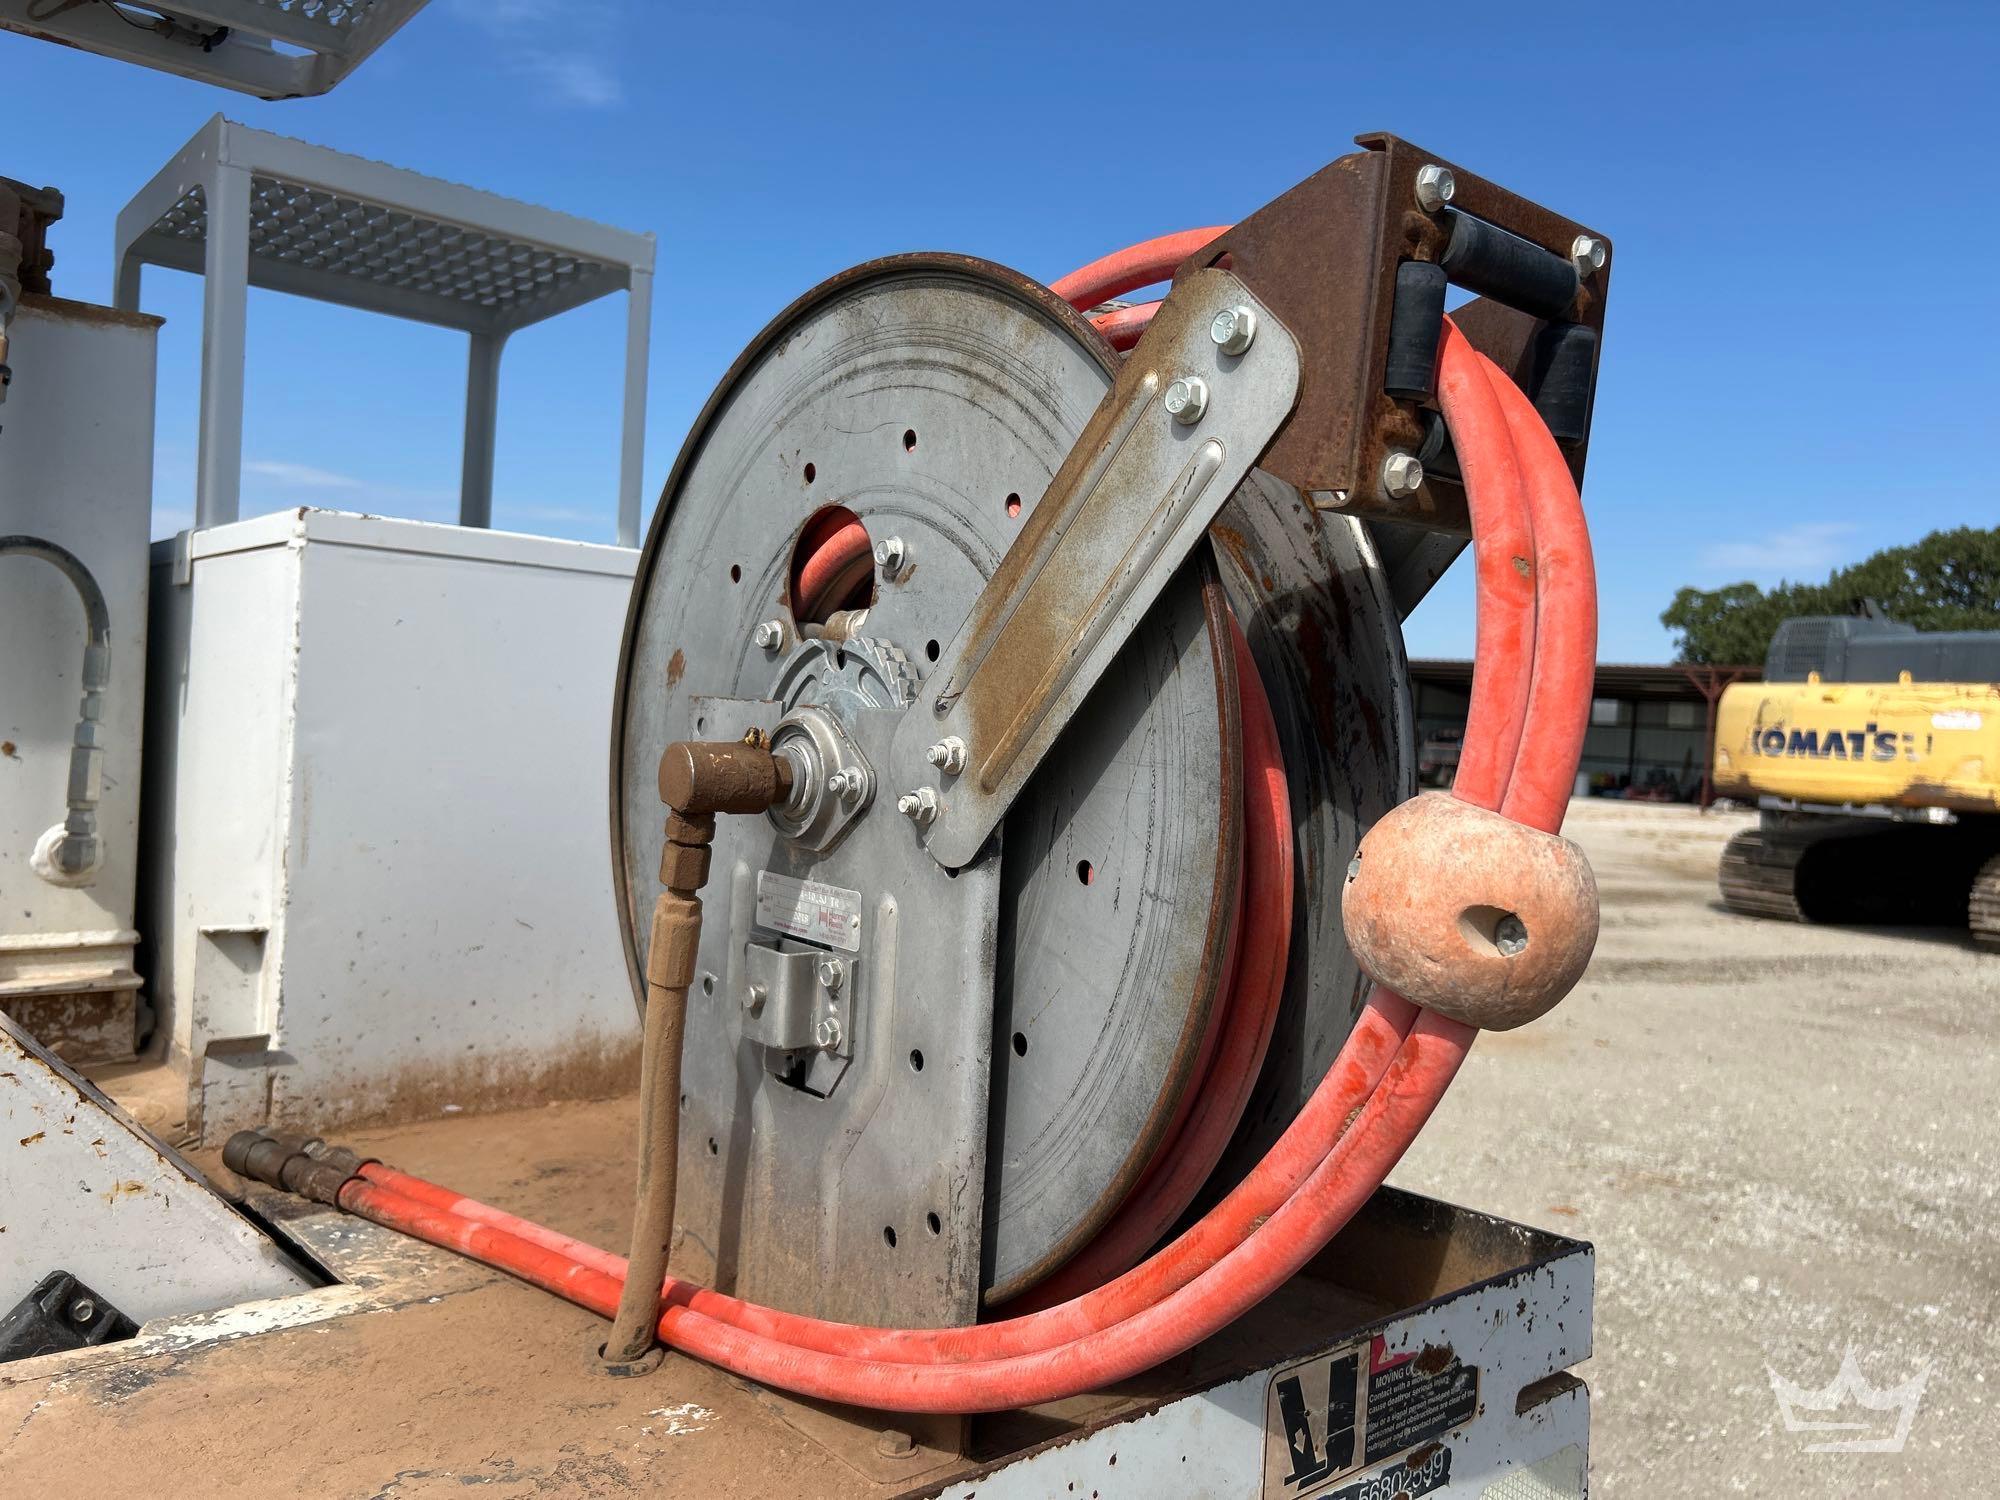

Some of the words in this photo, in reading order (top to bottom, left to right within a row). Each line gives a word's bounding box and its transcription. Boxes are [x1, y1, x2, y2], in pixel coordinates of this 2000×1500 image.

[1368, 1386, 1393, 1403] Contact
[1393, 1380, 1406, 1393] with
[1375, 1367, 1404, 1389] MOVING
[1368, 1401, 1386, 1414] cause
[1412, 1382, 1433, 1396] serious
[1379, 1416, 1386, 1424] or
[1408, 1400, 1427, 1414] person
[1366, 1437, 1393, 1453] outrigger
[1393, 1430, 1403, 1442] and
[1411, 1416, 1431, 1432] contact
[1367, 1423, 1395, 1443] personnel
[1395, 1418, 1406, 1429] and
[1406, 1404, 1439, 1424] obstructions
[1439, 1401, 1448, 1409] are
